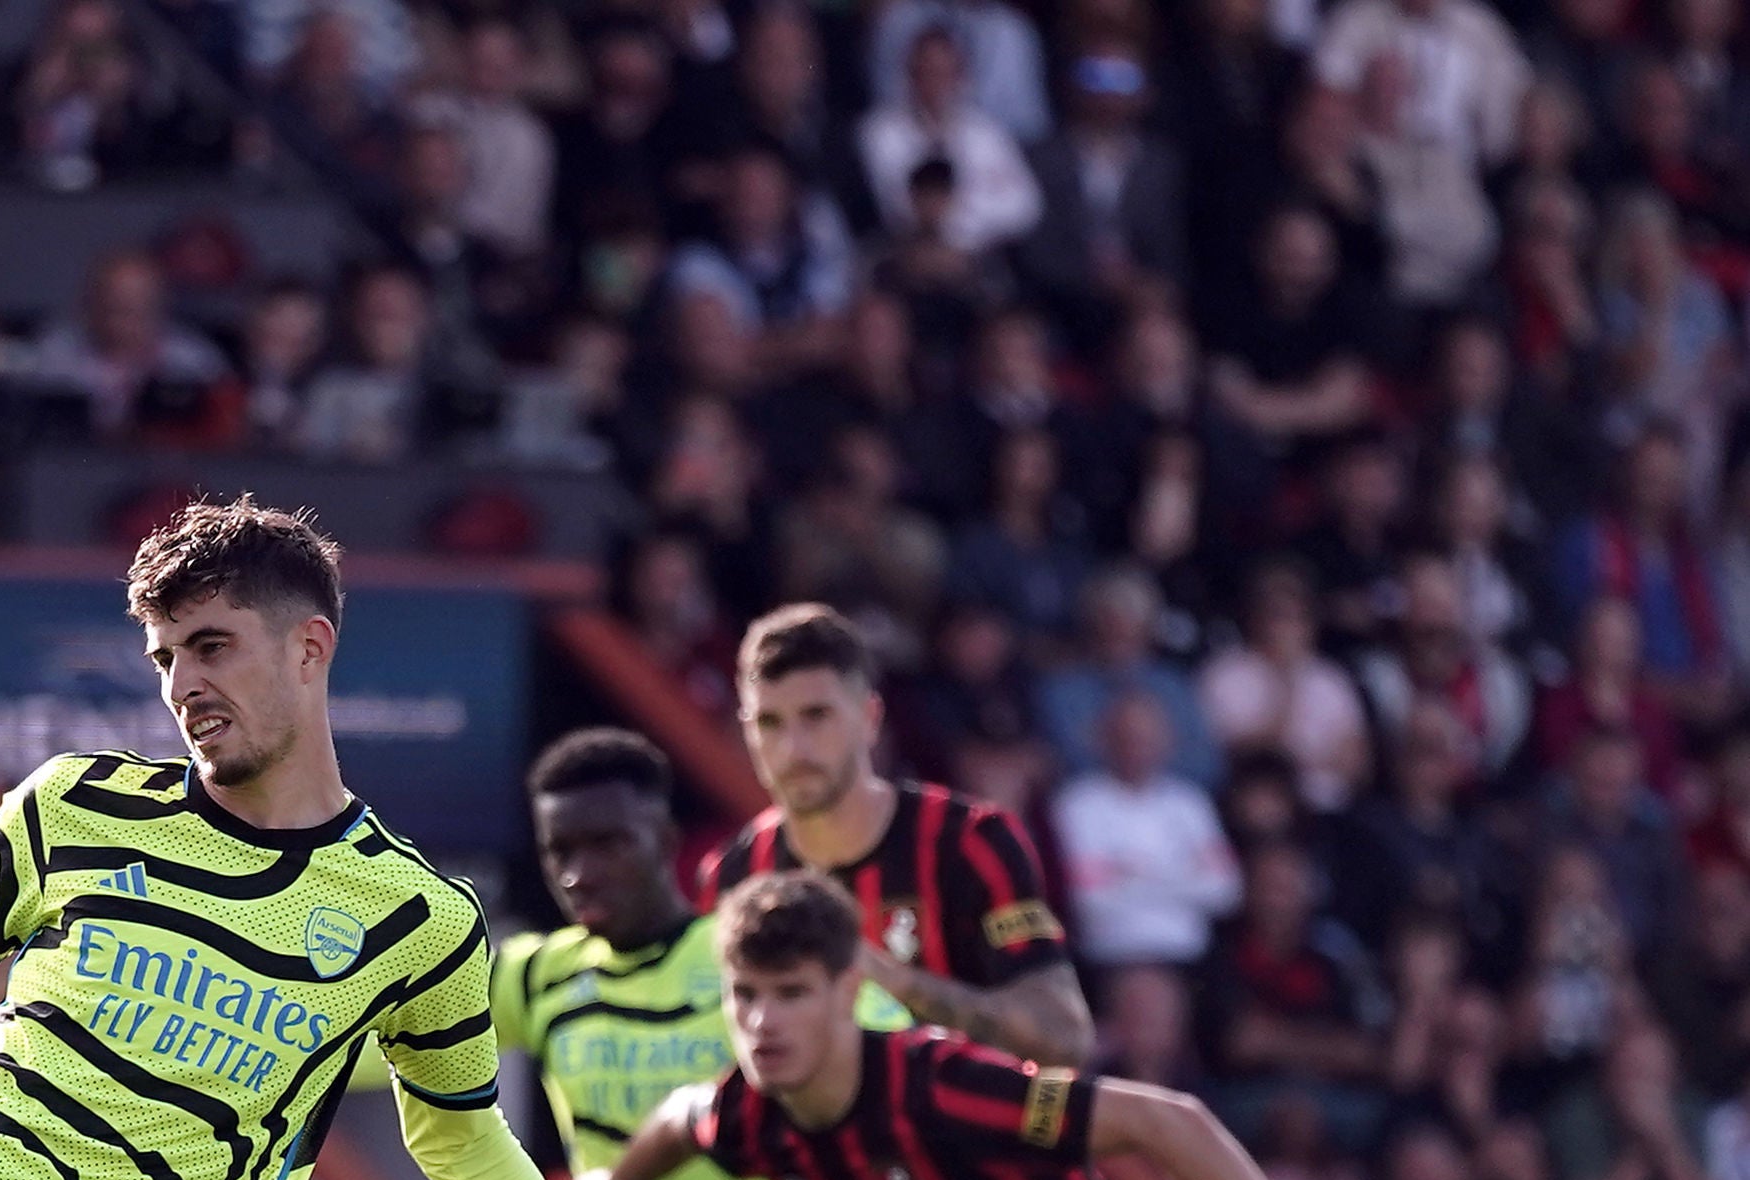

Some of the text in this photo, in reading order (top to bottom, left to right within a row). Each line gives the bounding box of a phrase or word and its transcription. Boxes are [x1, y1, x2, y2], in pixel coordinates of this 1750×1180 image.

[317, 917, 359, 942] Arsenal
[76, 923, 331, 1054] Emirates
[88, 993, 279, 1094] FLY BETTER
